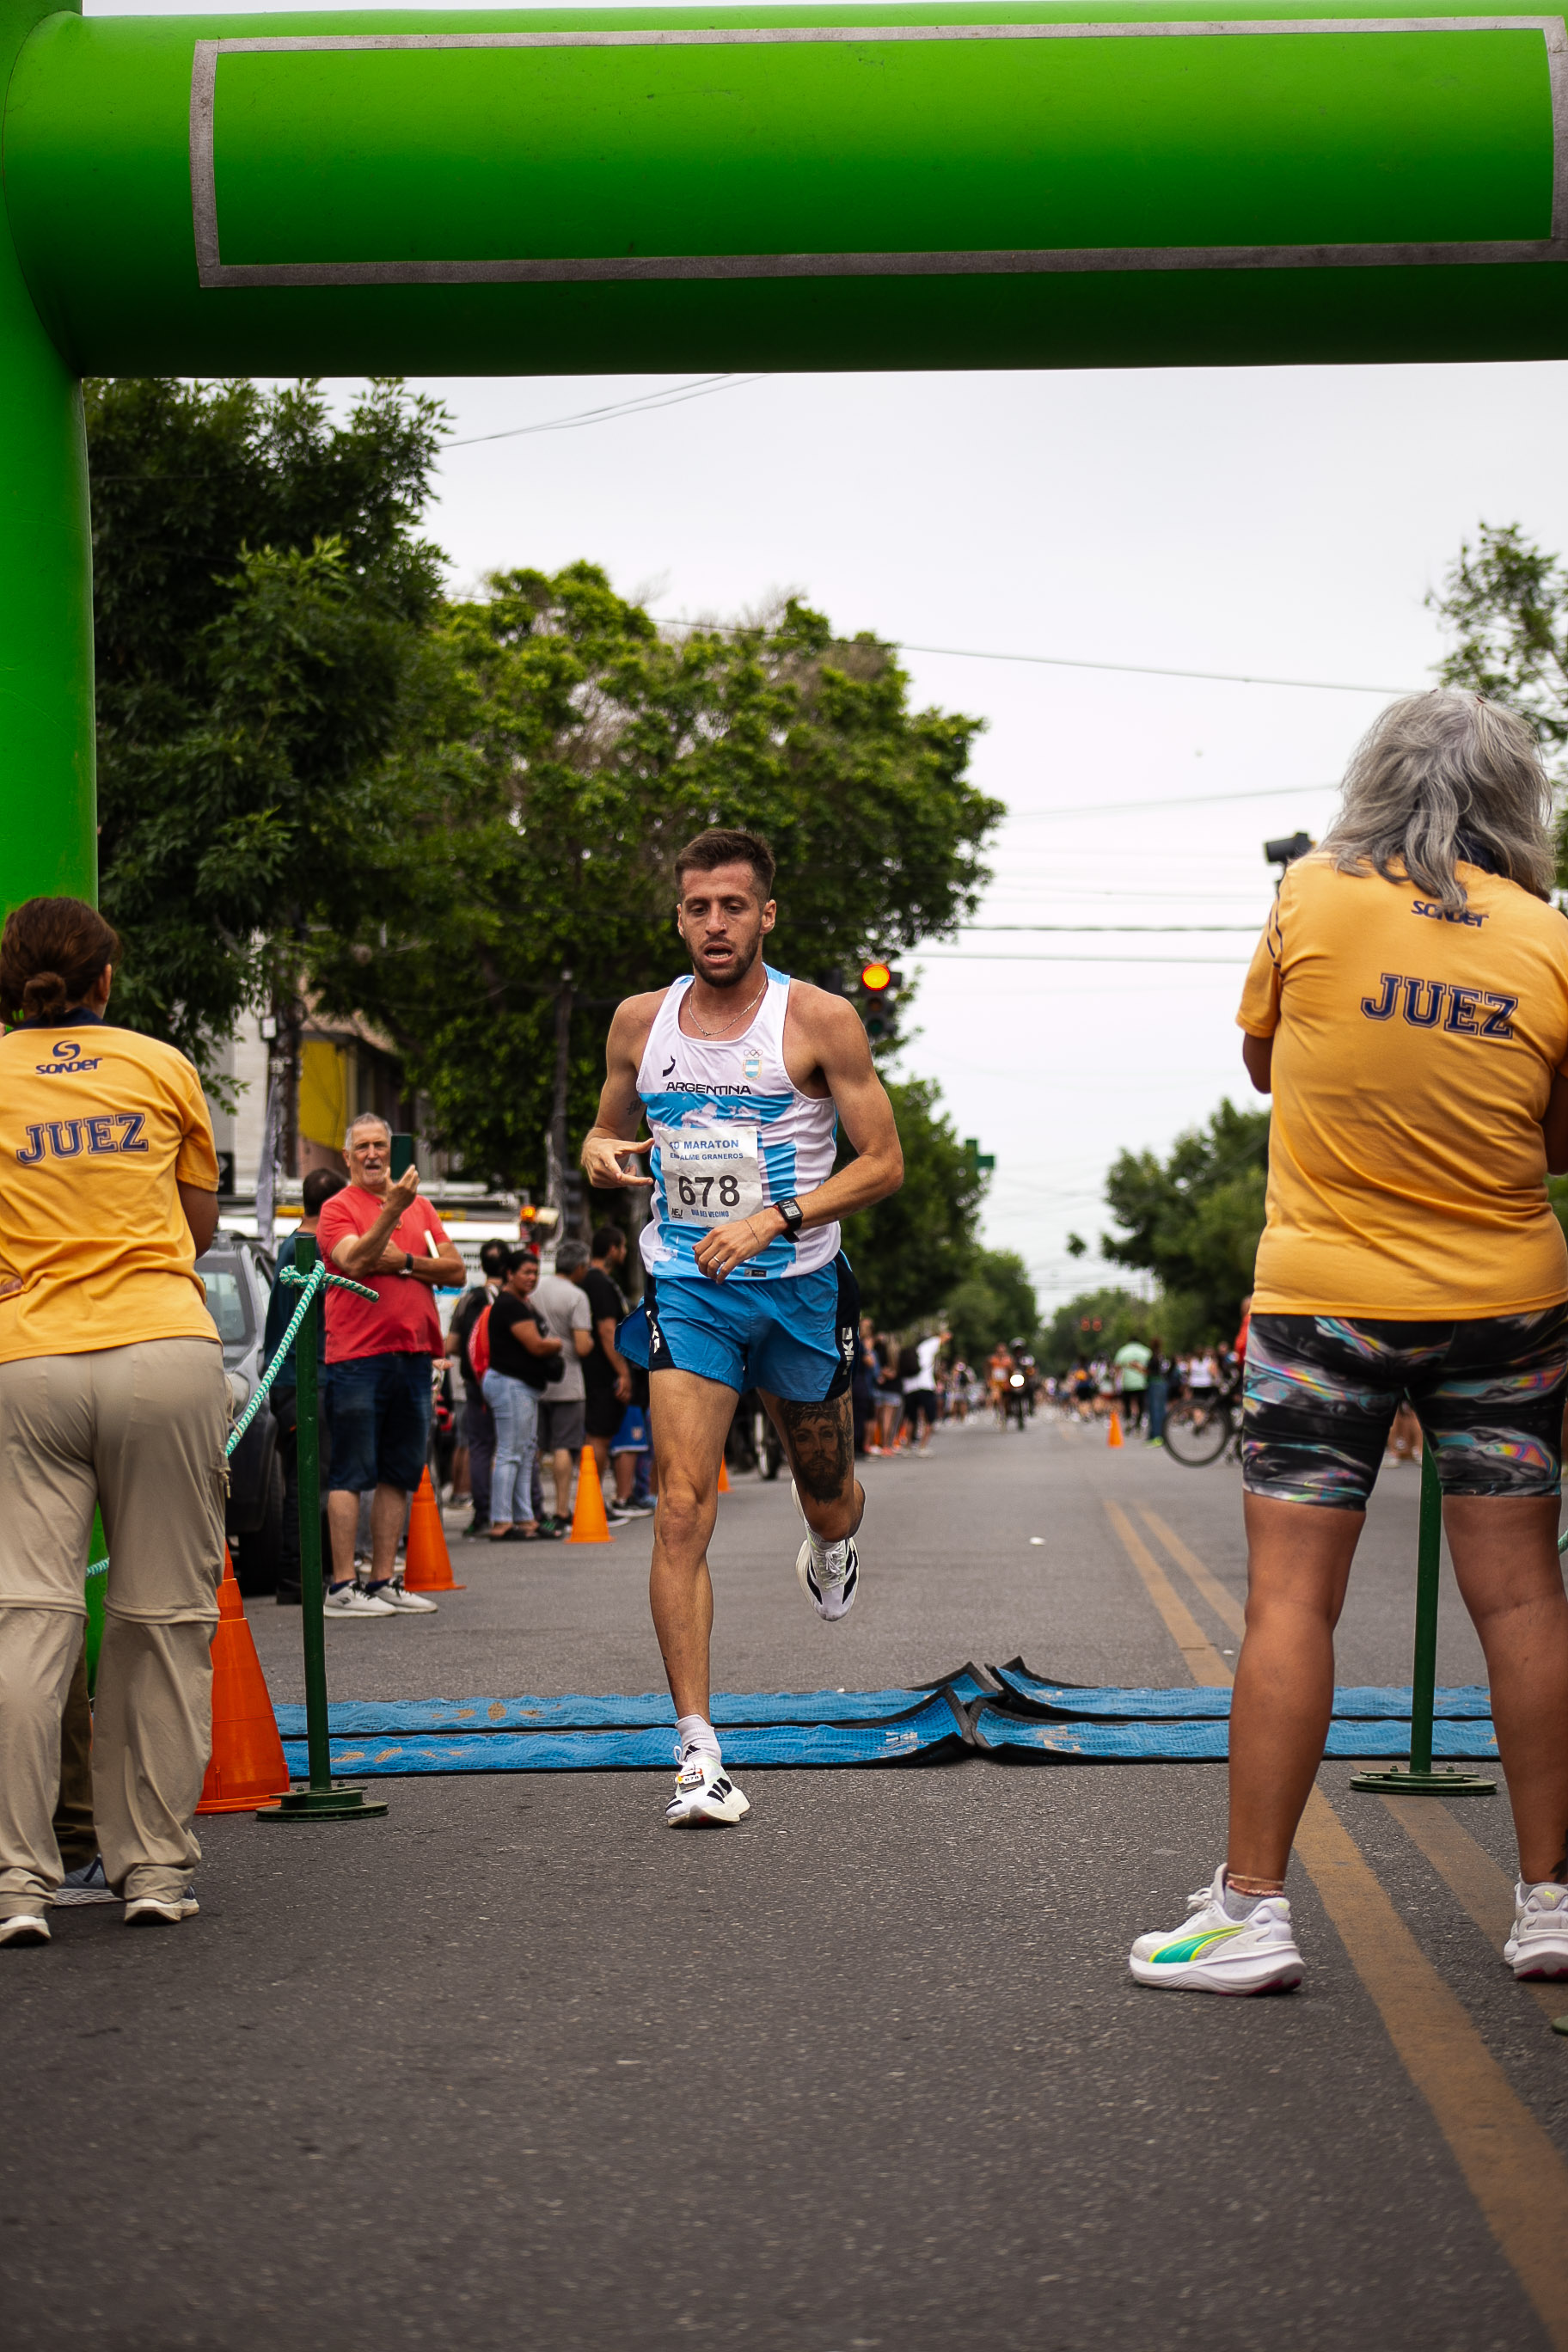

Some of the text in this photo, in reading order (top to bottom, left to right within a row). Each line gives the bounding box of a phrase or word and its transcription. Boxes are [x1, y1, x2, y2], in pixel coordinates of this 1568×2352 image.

[1360, 972, 1519, 1039] JUEZ
[665, 1081, 752, 1095] ARGENTINA
[16, 1112, 149, 1165] JUEZ
[683, 1139, 739, 1149] MARATON
[701, 1152, 744, 1161] GRANEROS
[678, 1174, 740, 1207] 678
